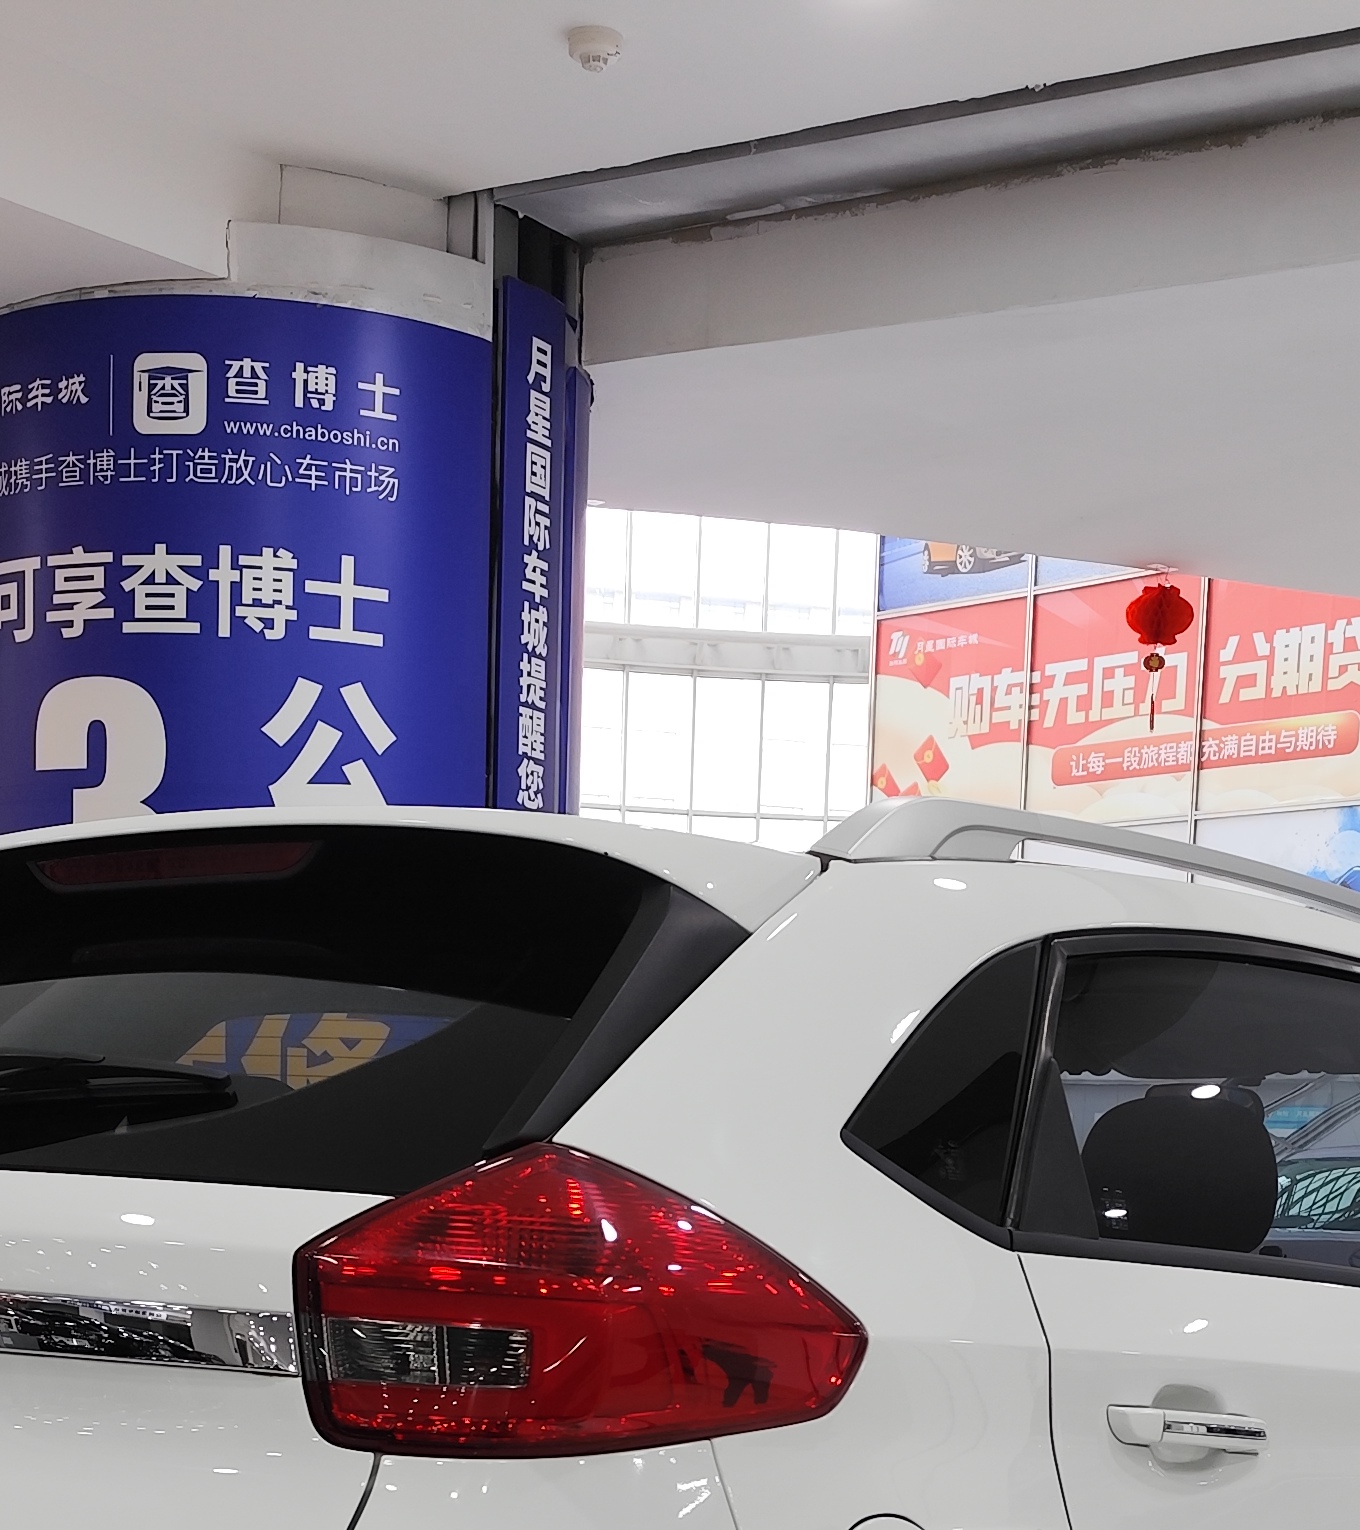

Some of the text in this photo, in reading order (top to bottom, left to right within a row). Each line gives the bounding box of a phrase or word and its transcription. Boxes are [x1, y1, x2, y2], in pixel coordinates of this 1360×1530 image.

[224, 357, 401, 422] 查博士
[223, 420, 400, 452] www.chaboshi.cn
[516, 336, 553, 811] 月星国际车城提醒您
[948, 645, 1189, 739] 购车无压力
